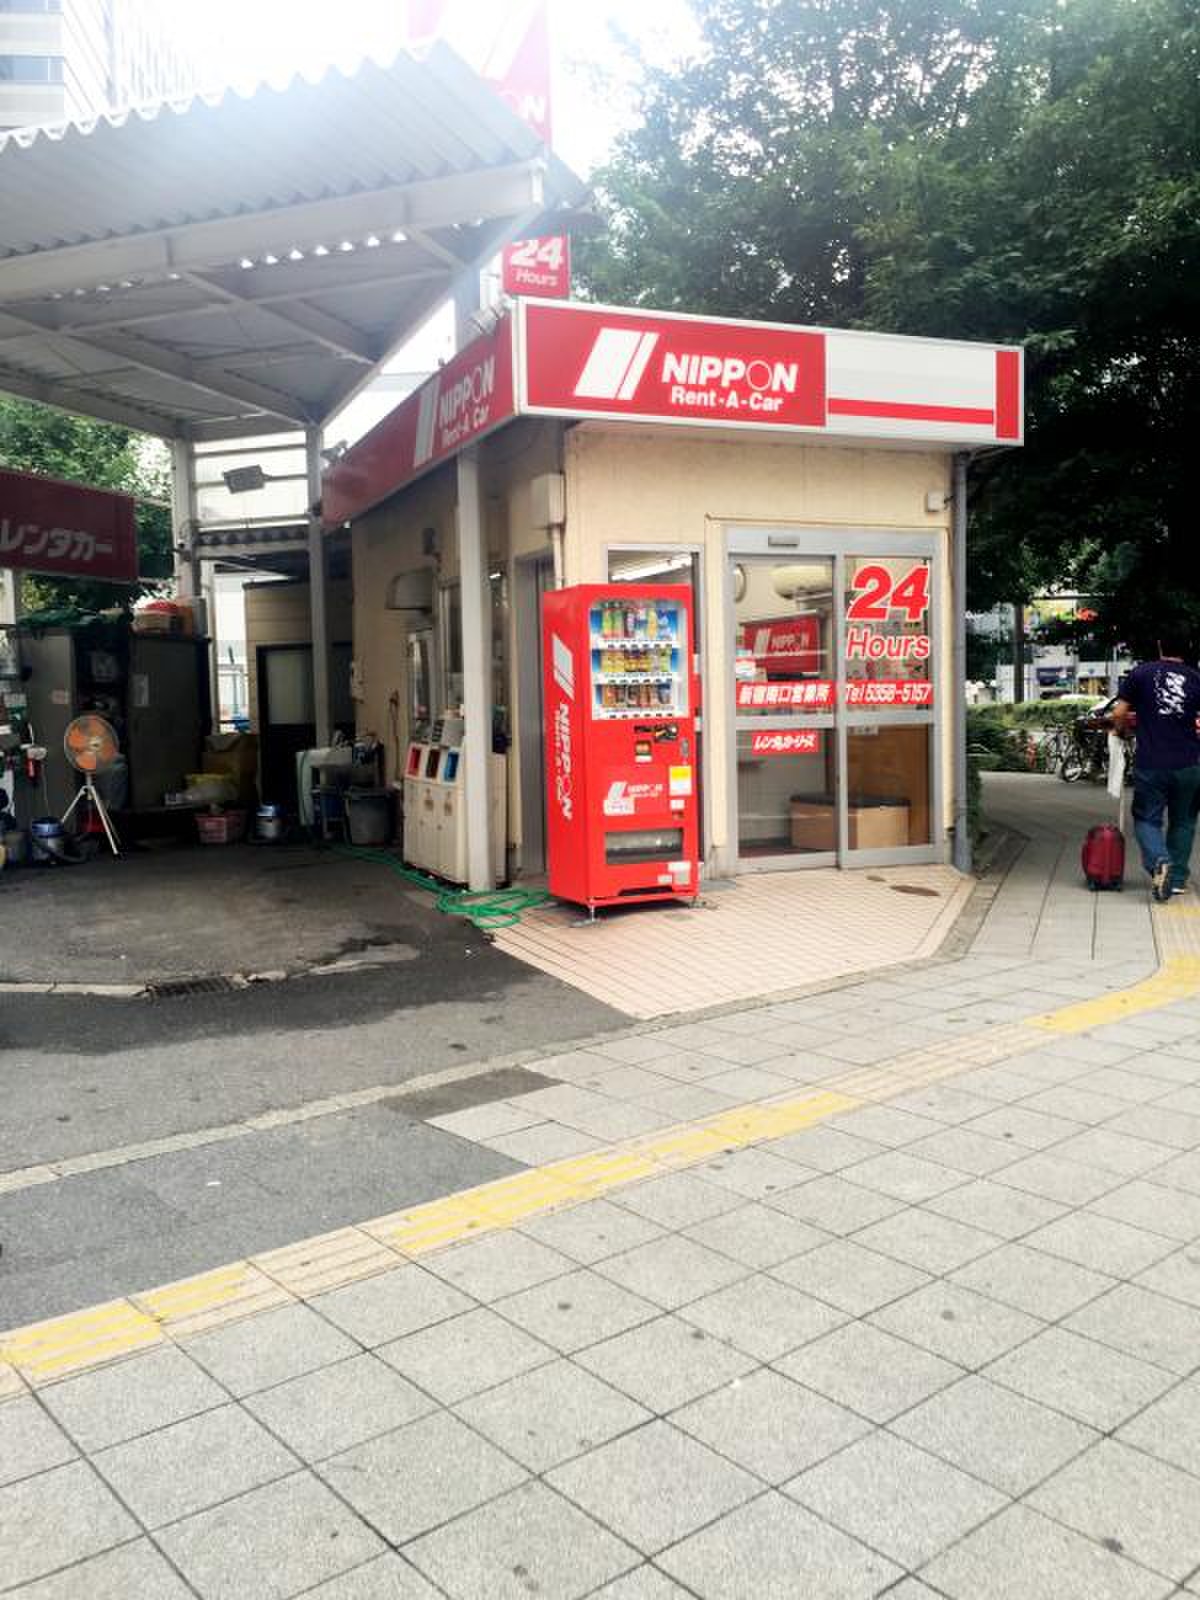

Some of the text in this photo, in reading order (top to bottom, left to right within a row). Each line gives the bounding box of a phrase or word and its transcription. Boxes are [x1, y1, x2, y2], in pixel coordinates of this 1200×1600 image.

[511, 237, 564, 270] 24
[514, 269, 558, 287] Hours
[661, 351, 799, 393] NIPPON
[439, 354, 495, 429] NIPPON
[847, 563, 930, 621] 24
[846, 626, 930, 661] Hours
